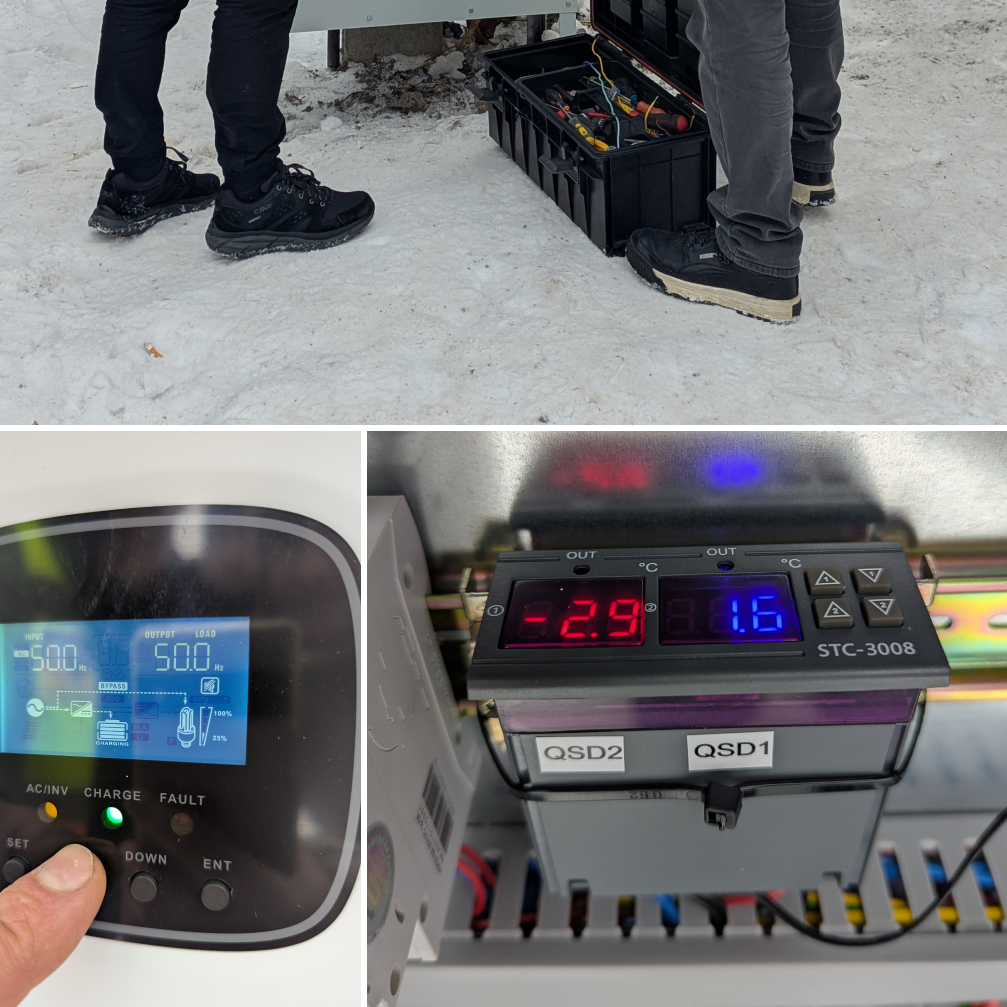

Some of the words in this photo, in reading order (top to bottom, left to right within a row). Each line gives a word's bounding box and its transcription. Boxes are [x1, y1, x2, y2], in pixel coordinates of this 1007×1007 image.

[566, 550, 597, 560] OUT
[706, 547, 737, 557] OUT
[24, 633, 45, 641] INPUT
[144, 630, 176, 639] OUTPUT
[195, 629, 217, 639] LOAD
[817, 641, 916, 657] STC-3008
[78, 664, 87, 672] Hz
[214, 664, 224, 672] Hz
[100, 682, 126, 690] BYPASS
[213, 710, 233, 718] 100%
[543, 745, 624, 761] QSD2
[694, 740, 770, 758] QSD1
[26, 783, 69, 796] AC/INV
[84, 787, 142, 801] CHARGE
[159, 792, 206, 806] FAULT
[7, 837, 30, 849] SET
[125, 850, 168, 865] DOWN
[203, 858, 233, 872] ENT
